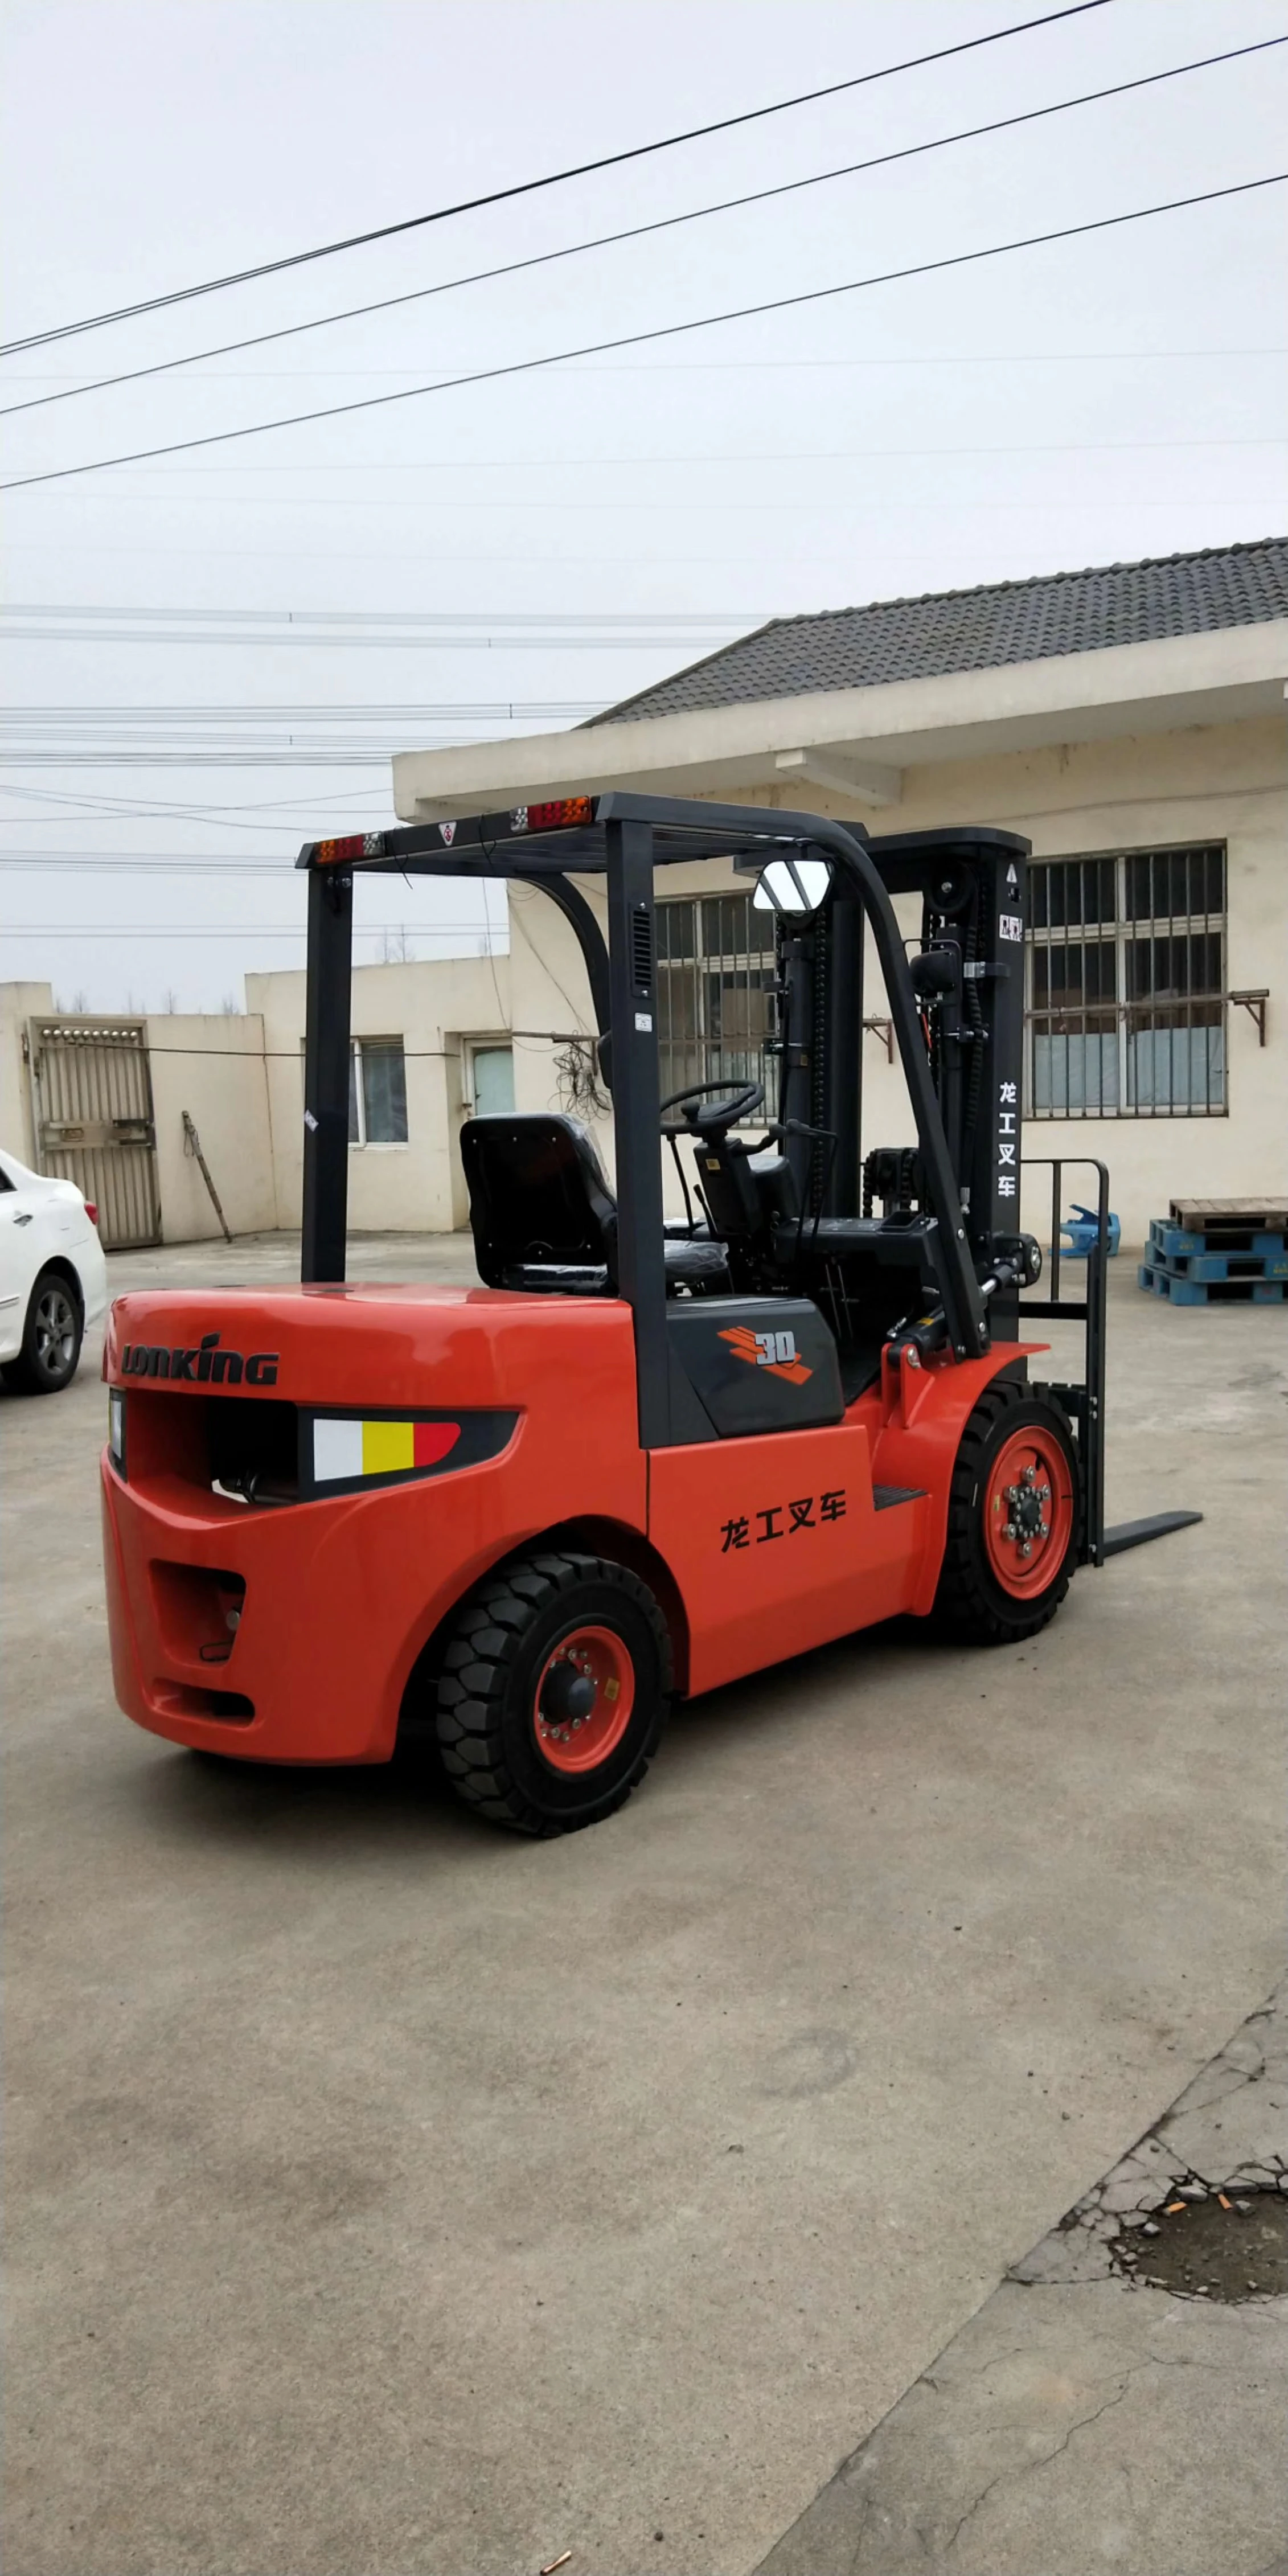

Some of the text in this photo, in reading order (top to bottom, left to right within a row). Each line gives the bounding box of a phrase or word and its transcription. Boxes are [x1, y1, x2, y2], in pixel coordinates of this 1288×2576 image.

[998, 1081, 1017, 1197] 龙工叉车
[755, 1331, 795, 1365] 30
[720, 1489, 847, 1554] 龙工叉车
